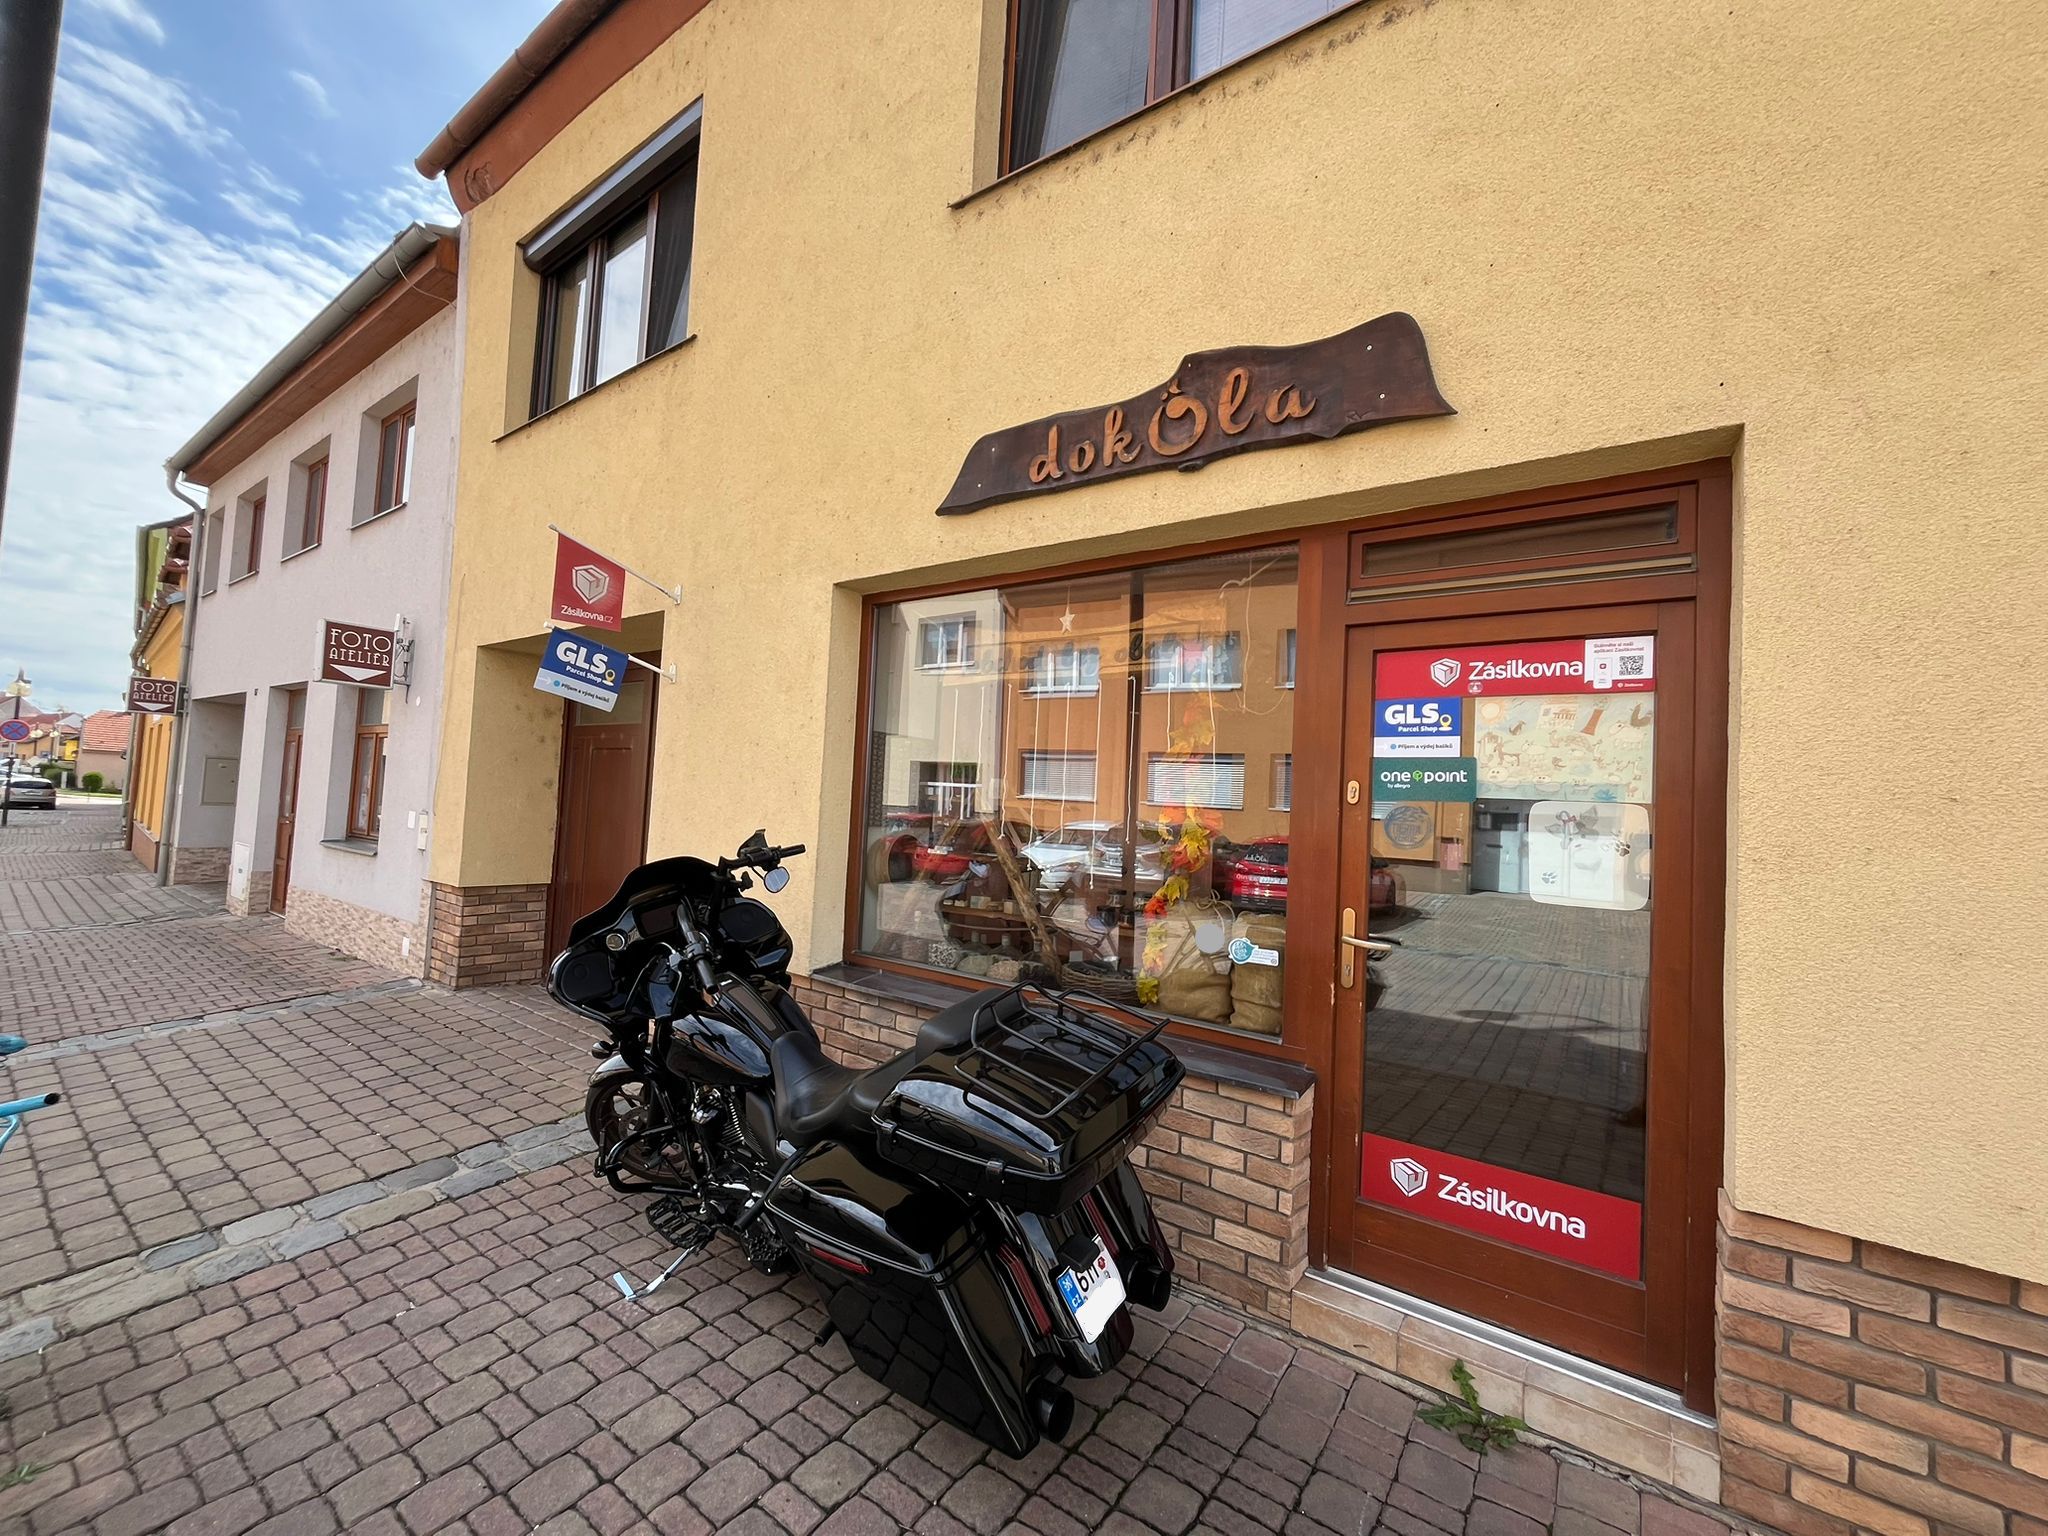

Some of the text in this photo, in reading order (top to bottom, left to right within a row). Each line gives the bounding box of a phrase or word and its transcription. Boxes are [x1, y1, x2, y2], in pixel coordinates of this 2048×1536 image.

[330, 629, 391, 652] FOTO
[329, 648, 390, 667] ATELIER
[557, 641, 608, 674] GLS
[566, 665, 602, 683] Parcel Shop
[1468, 659, 1583, 681] Zásilkovna
[134, 681, 176, 694] FOTO
[133, 692, 175, 702] ATELIER
[1385, 703, 1440, 725] GLS
[1420, 725, 1438, 733] Shop
[1381, 770, 1468, 784] one point
[1438, 1174, 1586, 1239] Zásilkovna
[1071, 1294, 1082, 1308] CZ
